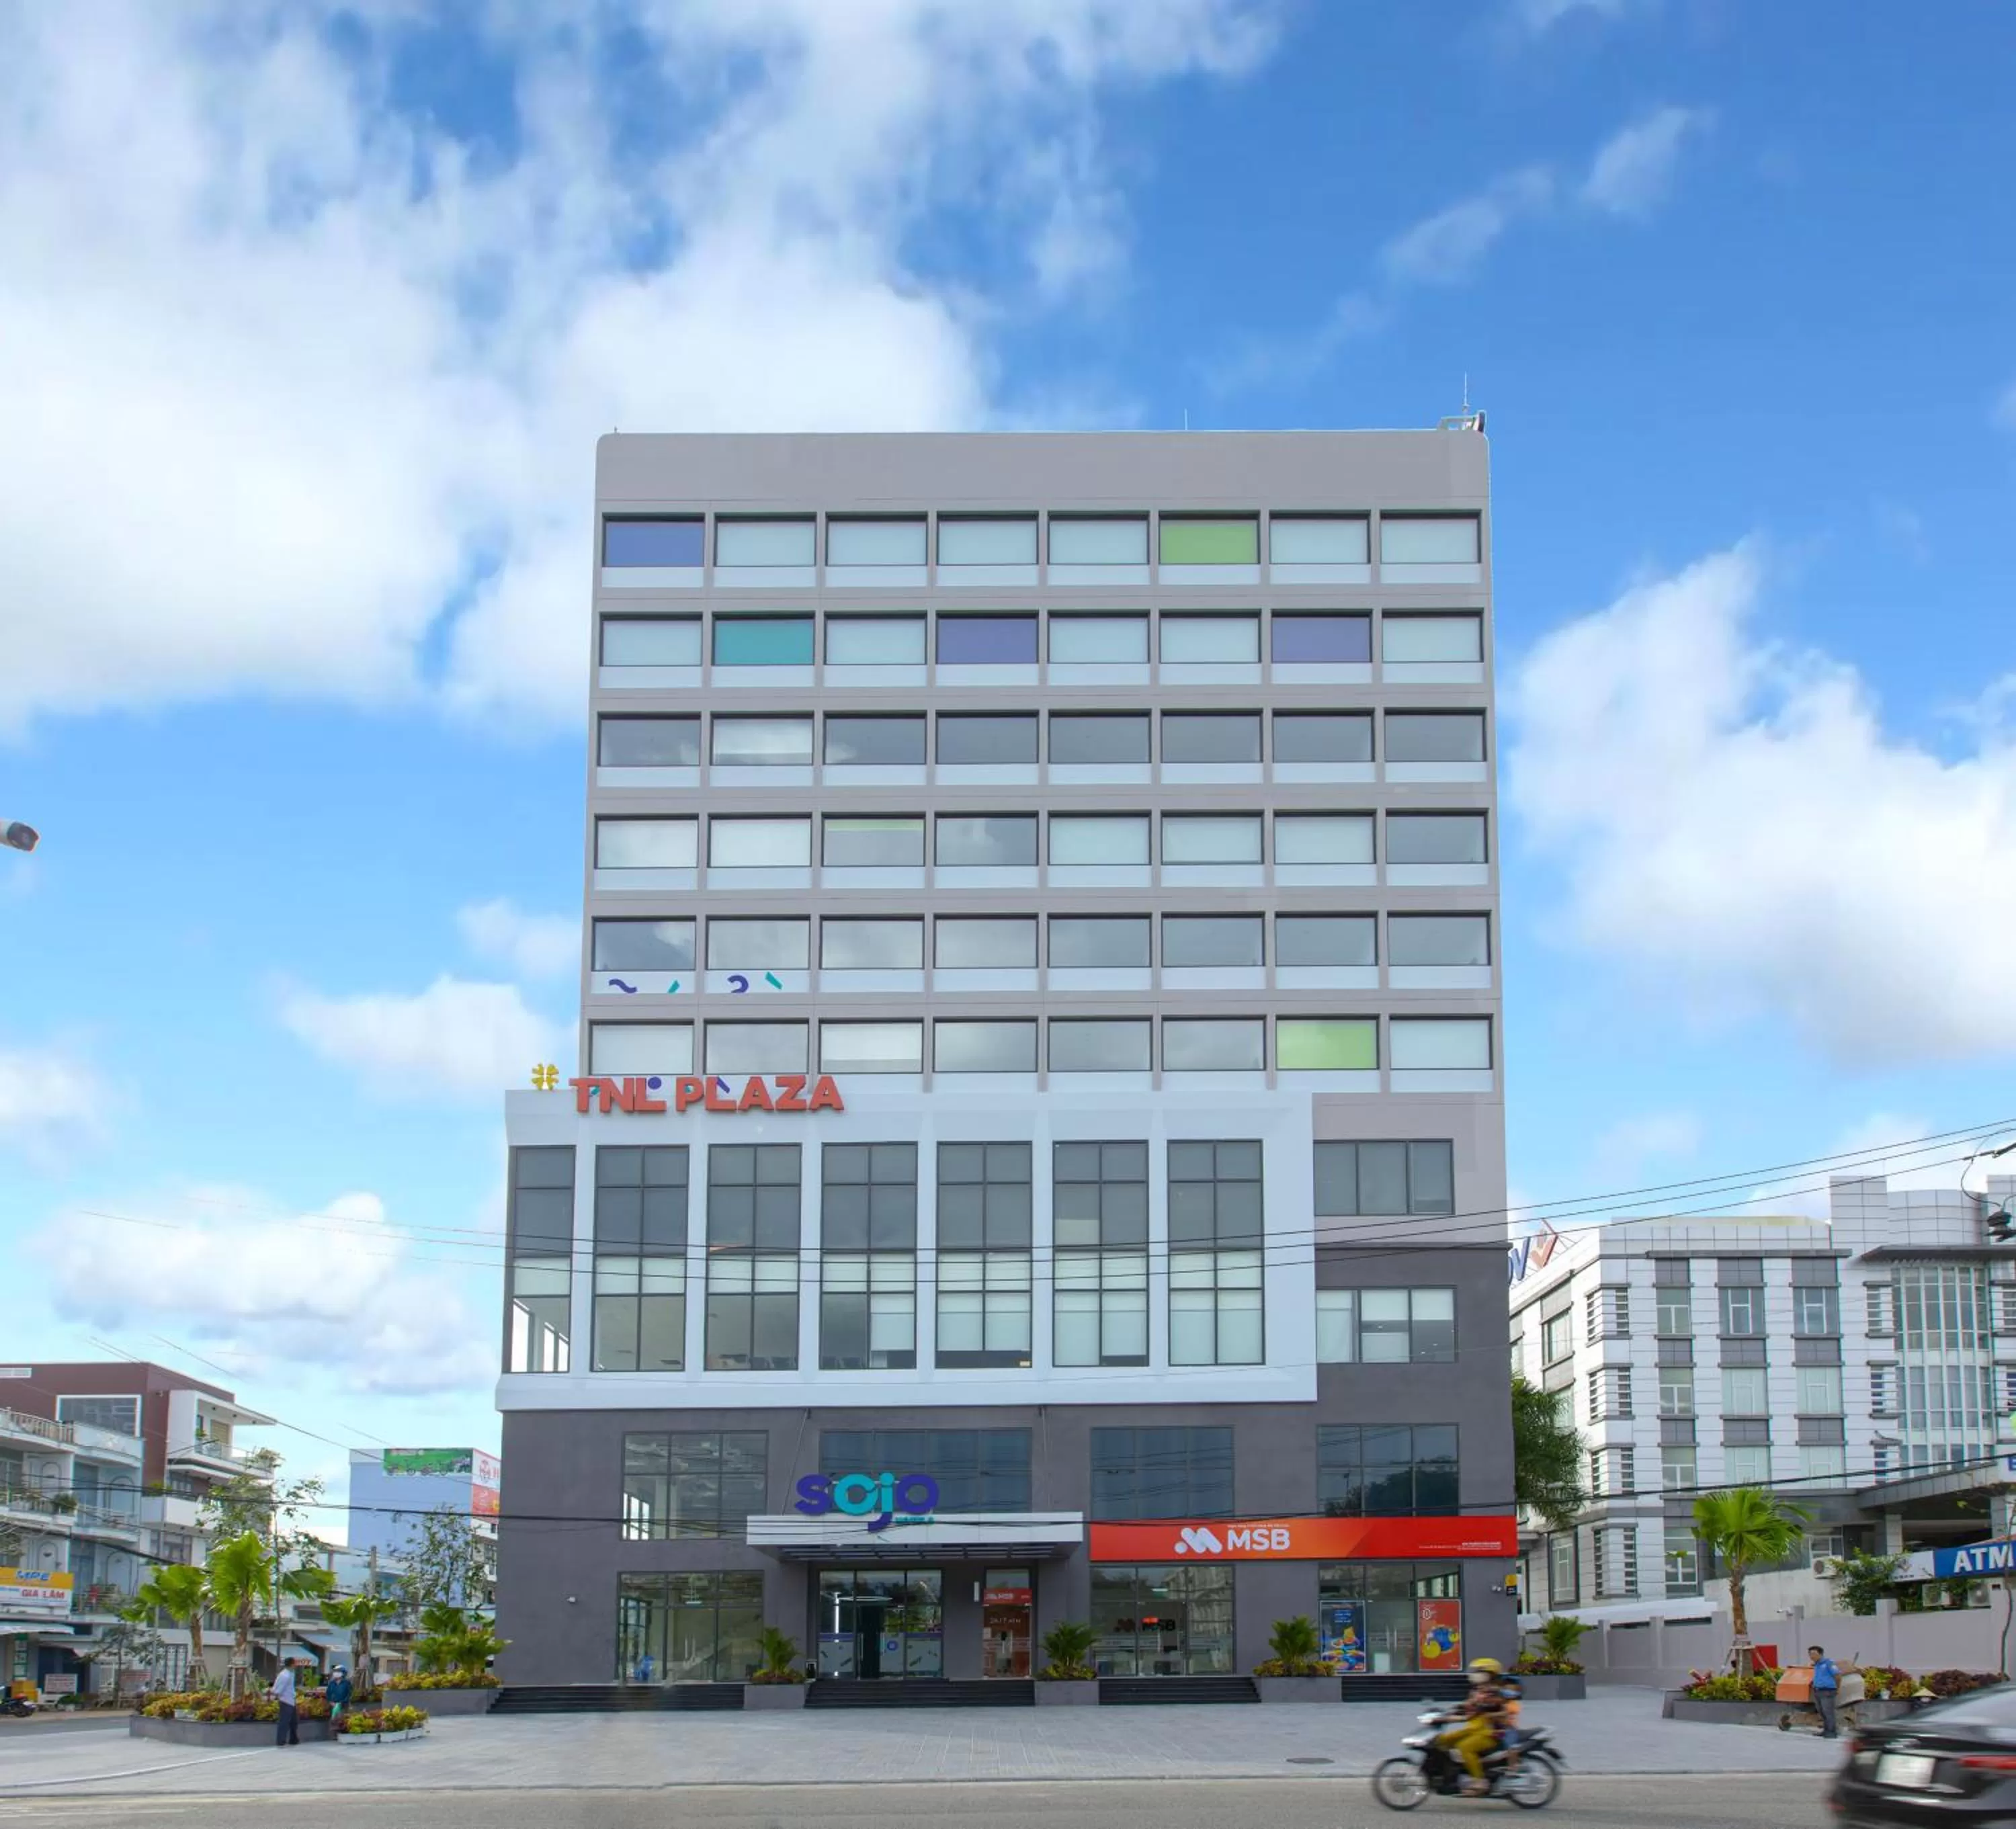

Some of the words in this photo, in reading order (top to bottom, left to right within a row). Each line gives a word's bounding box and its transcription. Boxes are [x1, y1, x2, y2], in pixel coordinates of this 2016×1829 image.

[569, 1076, 667, 1113] TNL
[675, 1075, 845, 1112] PLAZA
[795, 1472, 939, 1533] sojo
[1228, 1529, 1290, 1551] MSB
[1954, 1544, 2014, 1573] ATM
